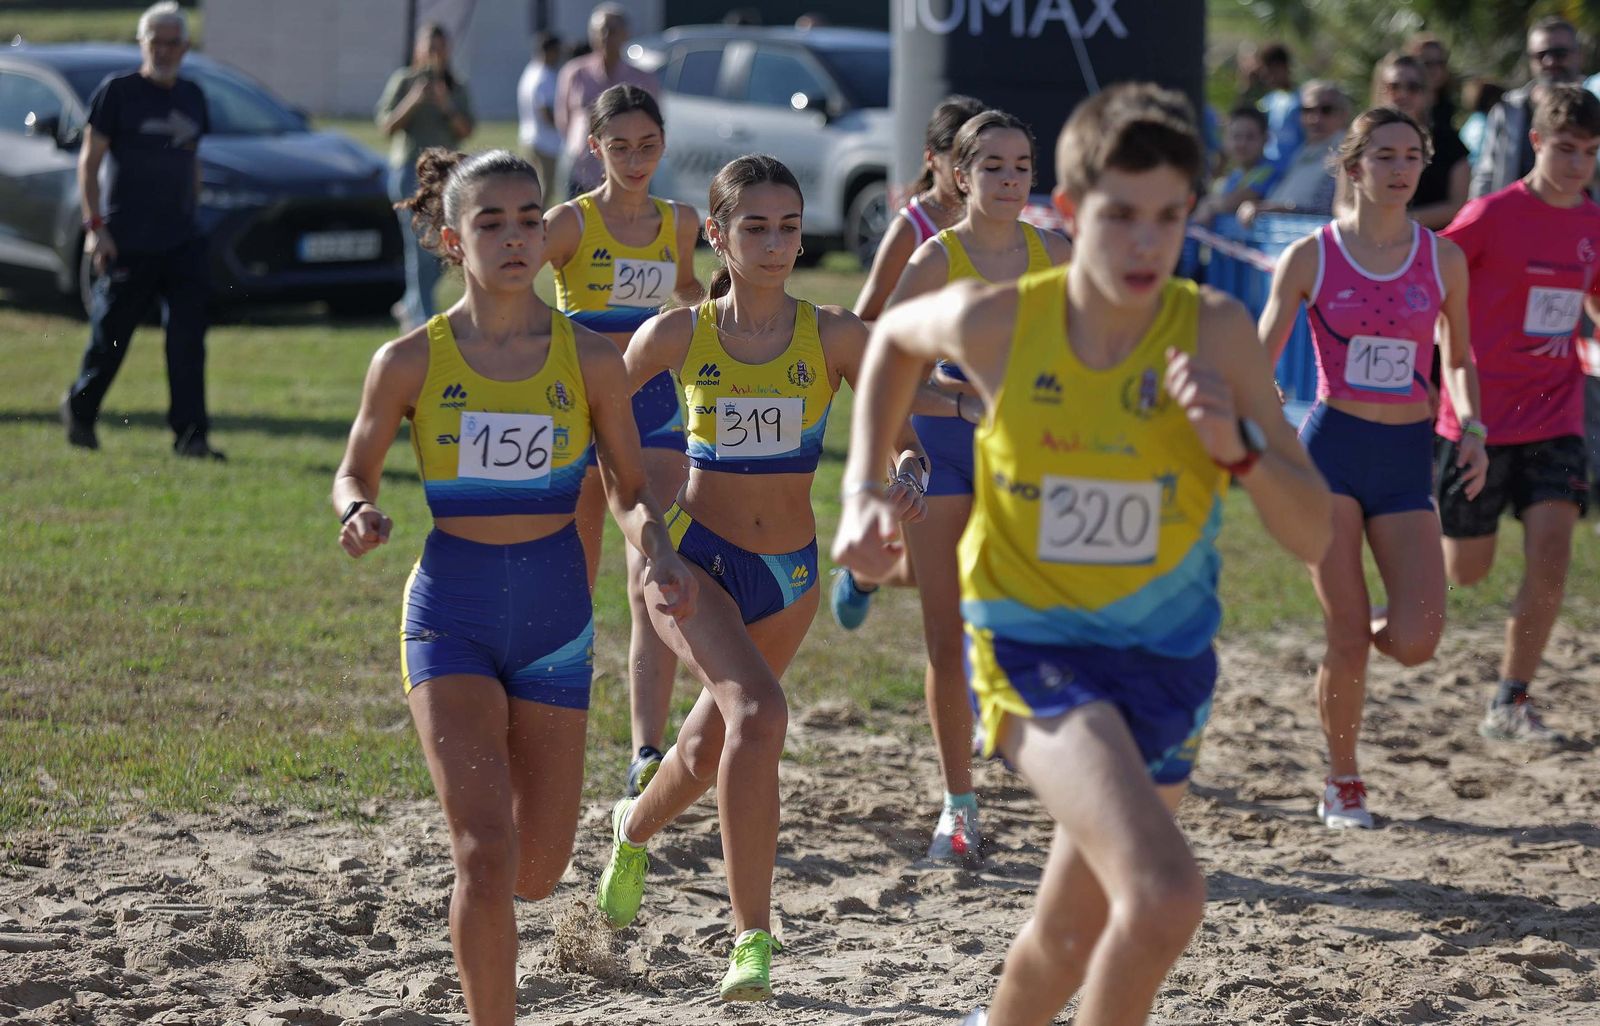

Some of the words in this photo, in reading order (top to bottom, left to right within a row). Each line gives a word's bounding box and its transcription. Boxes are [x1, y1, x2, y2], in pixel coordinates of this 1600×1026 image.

[615, 266, 662, 300] 312
[1355, 345, 1410, 382] 153
[696, 379, 720, 387] mobel
[721, 407, 782, 447] 319
[473, 424, 549, 470] 156
[1049, 485, 1152, 548] 320
